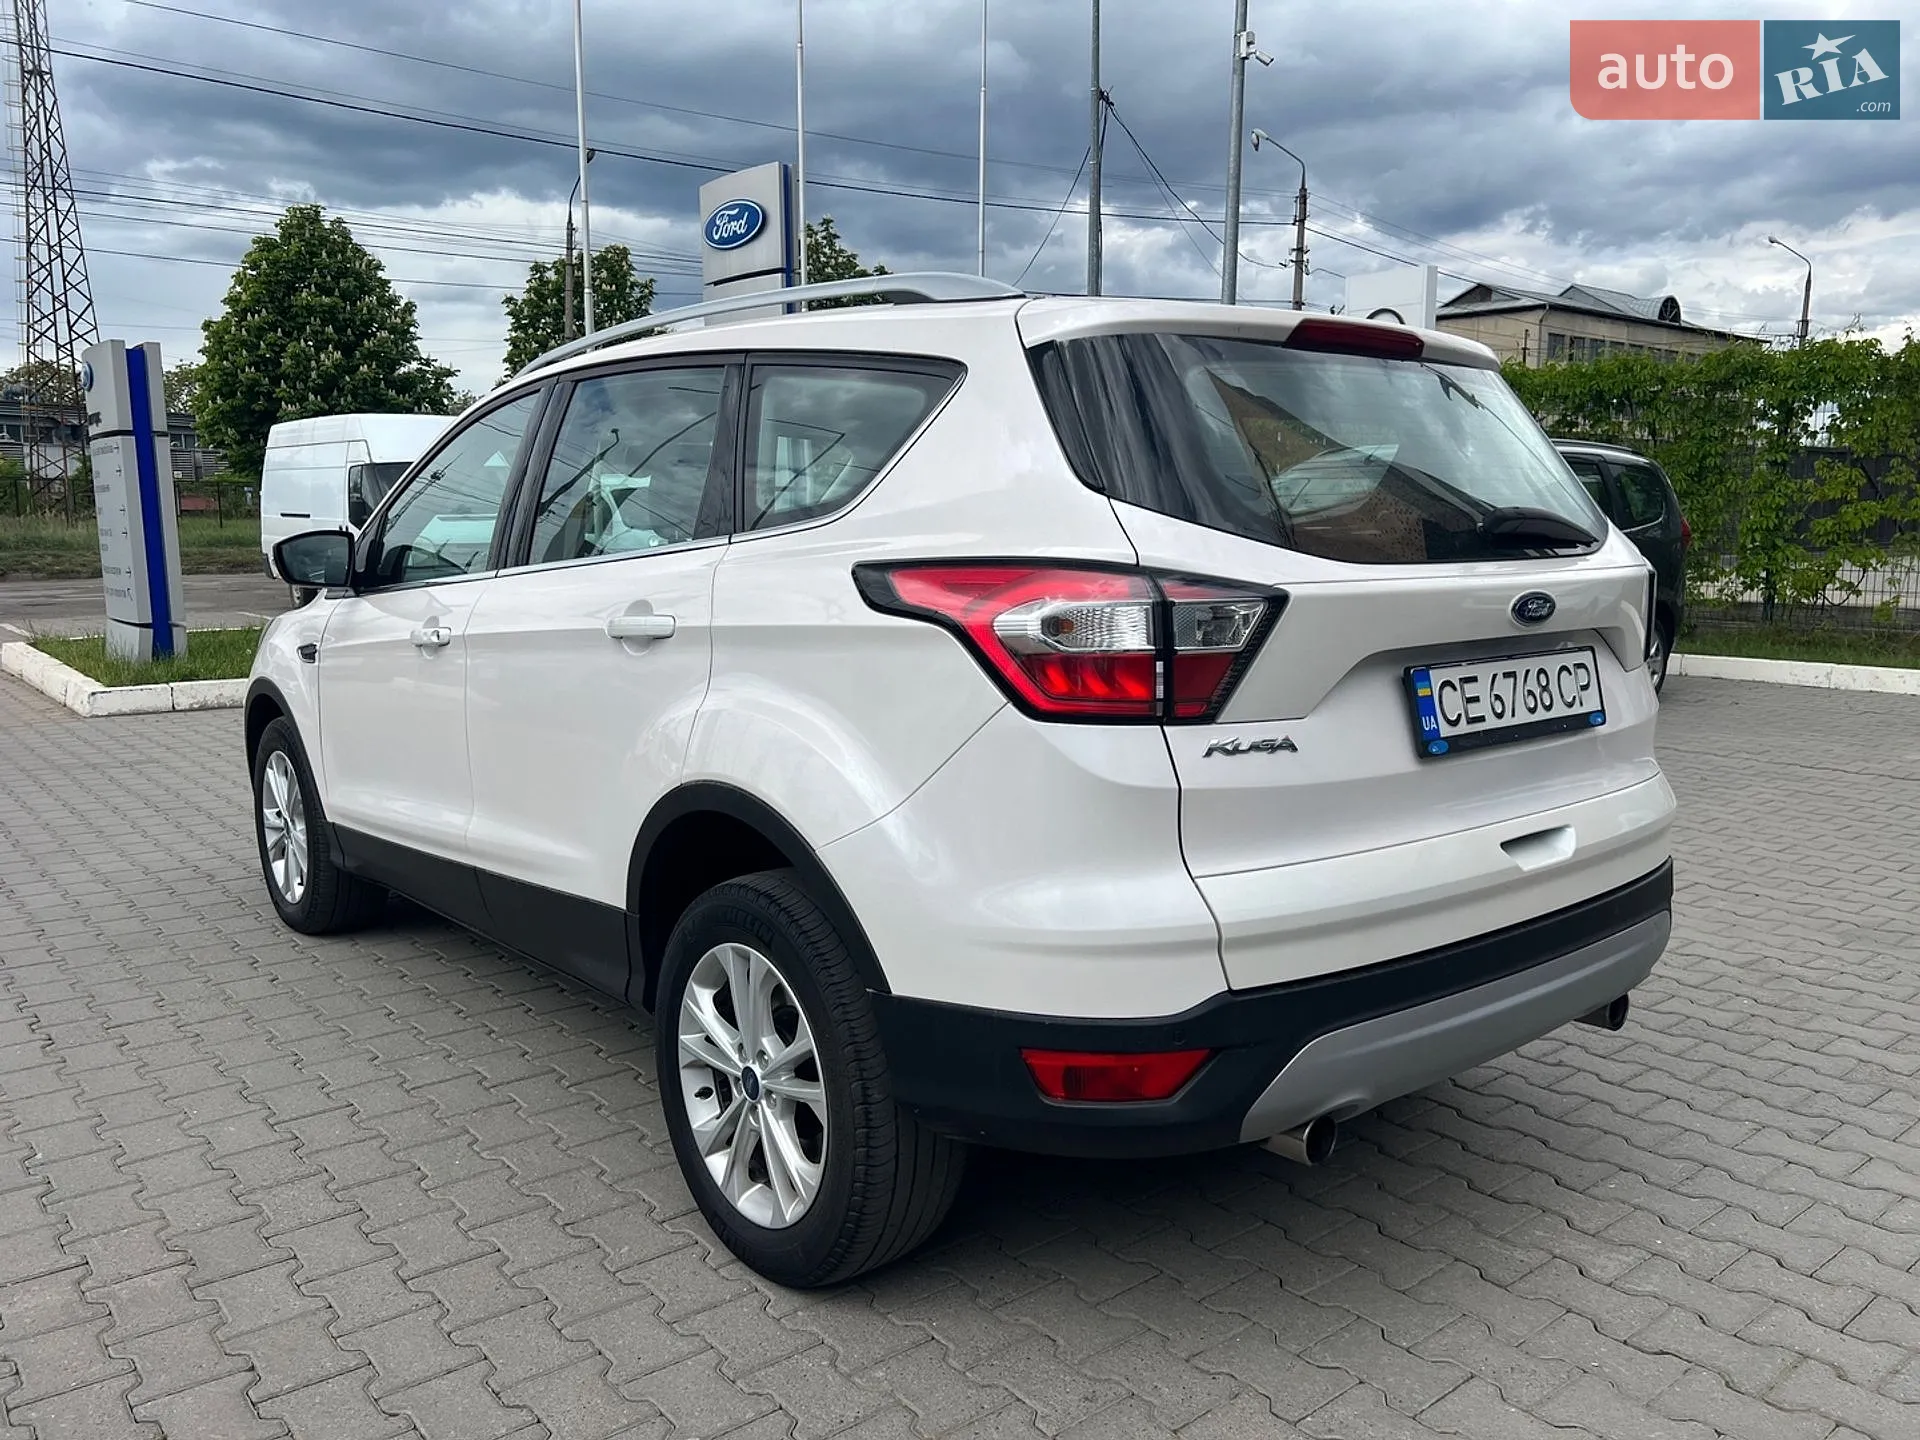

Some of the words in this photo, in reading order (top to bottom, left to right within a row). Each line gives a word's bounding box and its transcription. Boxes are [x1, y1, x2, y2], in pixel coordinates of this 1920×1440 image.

[713, 208, 748, 240] Ford
[1525, 599, 1550, 617] Ford
[1422, 715, 1438, 731] UA
[1202, 735, 1299, 758] KUGA
